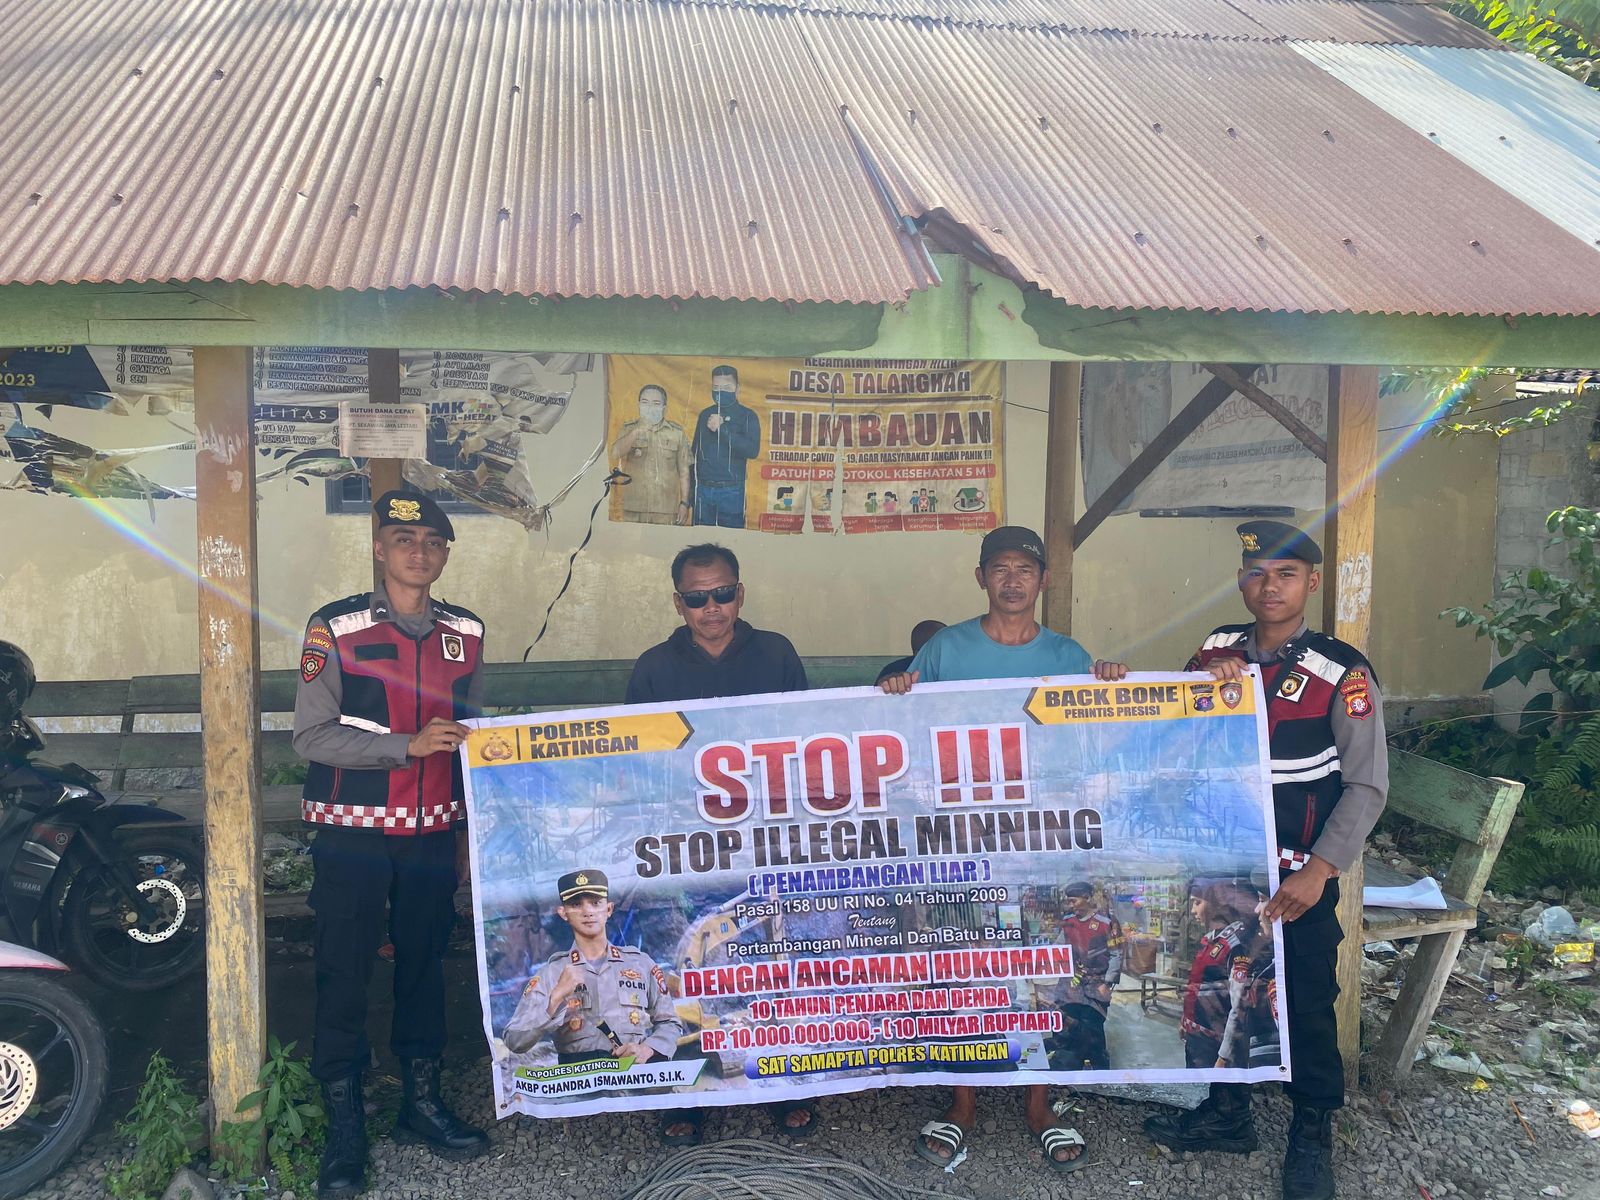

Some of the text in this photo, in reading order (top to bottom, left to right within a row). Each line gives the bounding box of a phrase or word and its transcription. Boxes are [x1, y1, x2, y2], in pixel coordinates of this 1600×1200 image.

[117, 353, 173, 366] 3) PIK REMAJA
[292, 354, 330, 363] KOMPUTER
[444, 351, 483, 361] ZONASI
[874, 359, 929, 369] KATINGAN
[930, 359, 959, 369] HILIR
[116, 364, 172, 376] 4) OLAHRAGA
[269, 362, 294, 371] TEKNIK
[295, 363, 319, 372] AUDIO
[326, 365, 347, 374] VIDEO
[444, 361, 490, 371] AFIRMASI
[130, 374, 148, 384] SENI
[268, 371, 292, 380] TEKNIK
[292, 373, 334, 383] KENDARAAN
[336, 376, 363, 386] RINGAN
[443, 370, 488, 380] PRESTASI
[789, 370, 971, 394] DESA TALANGKAH
[267, 380, 293, 391] DESAIN
[294, 382, 336, 393] PEMODELAN
[770, 410, 992, 448] HIMBAUAN
[769, 451, 809, 463] TERHADAP
[810, 452, 835, 463] COVID
[858, 452, 880, 463] AGAR
[880, 451, 930, 463] MASYARAKAT
[931, 451, 959, 462] JANGAN
[960, 450, 984, 461] PANIK
[771, 467, 812, 479] PATUHI
[893, 467, 963, 479] KESEHATAN
[965, 466, 973, 478] 5
[976, 467, 987, 478] M
[1044, 688, 1110, 708] BACK
[1115, 686, 1179, 704] BONE
[1064, 706, 1161, 719] PERINTIS PRESISI
[529, 720, 610, 741] POLRES
[530, 735, 639, 760] KATINGAN
[697, 724, 1029, 823] STOP !!!
[634, 808, 1104, 878] STOP ILLEGAL MINNING
[13, 880, 41, 892] YAMAHA
[763, 863, 923, 896] PENAMBANGAN
[931, 860, 978, 884] LIAR
[736, 887, 1007, 918] Pasal 158 UU RI No. 04 Tahun 2009
[848, 913, 897, 931] Tentang
[727, 926, 1022, 958] Pertambangan Mineral Dan Batu Bara
[682, 947, 1072, 998] DENGAN ANCAMAN HUKUMAN
[618, 980, 646, 991] POLRI
[749, 987, 1010, 1020] 10 TAHUN PENJARA DAN DENDA
[702, 1029, 728, 1051] RP.
[729, 1019, 881, 1048] 10.000.000.000,-
[893, 1017, 913, 1038] 10
[917, 1015, 979, 1036] MILYAR
[983, 1012, 1050, 1034] RUPIAH
[757, 1041, 1008, 1075] SAT SAMAPTA POLRES KATINGAN
[526, 1061, 619, 1078] KAPOLRES KATINGAN
[515, 1070, 686, 1095] AKBP CHANDRA ISMAWANTO, S.I.K.
